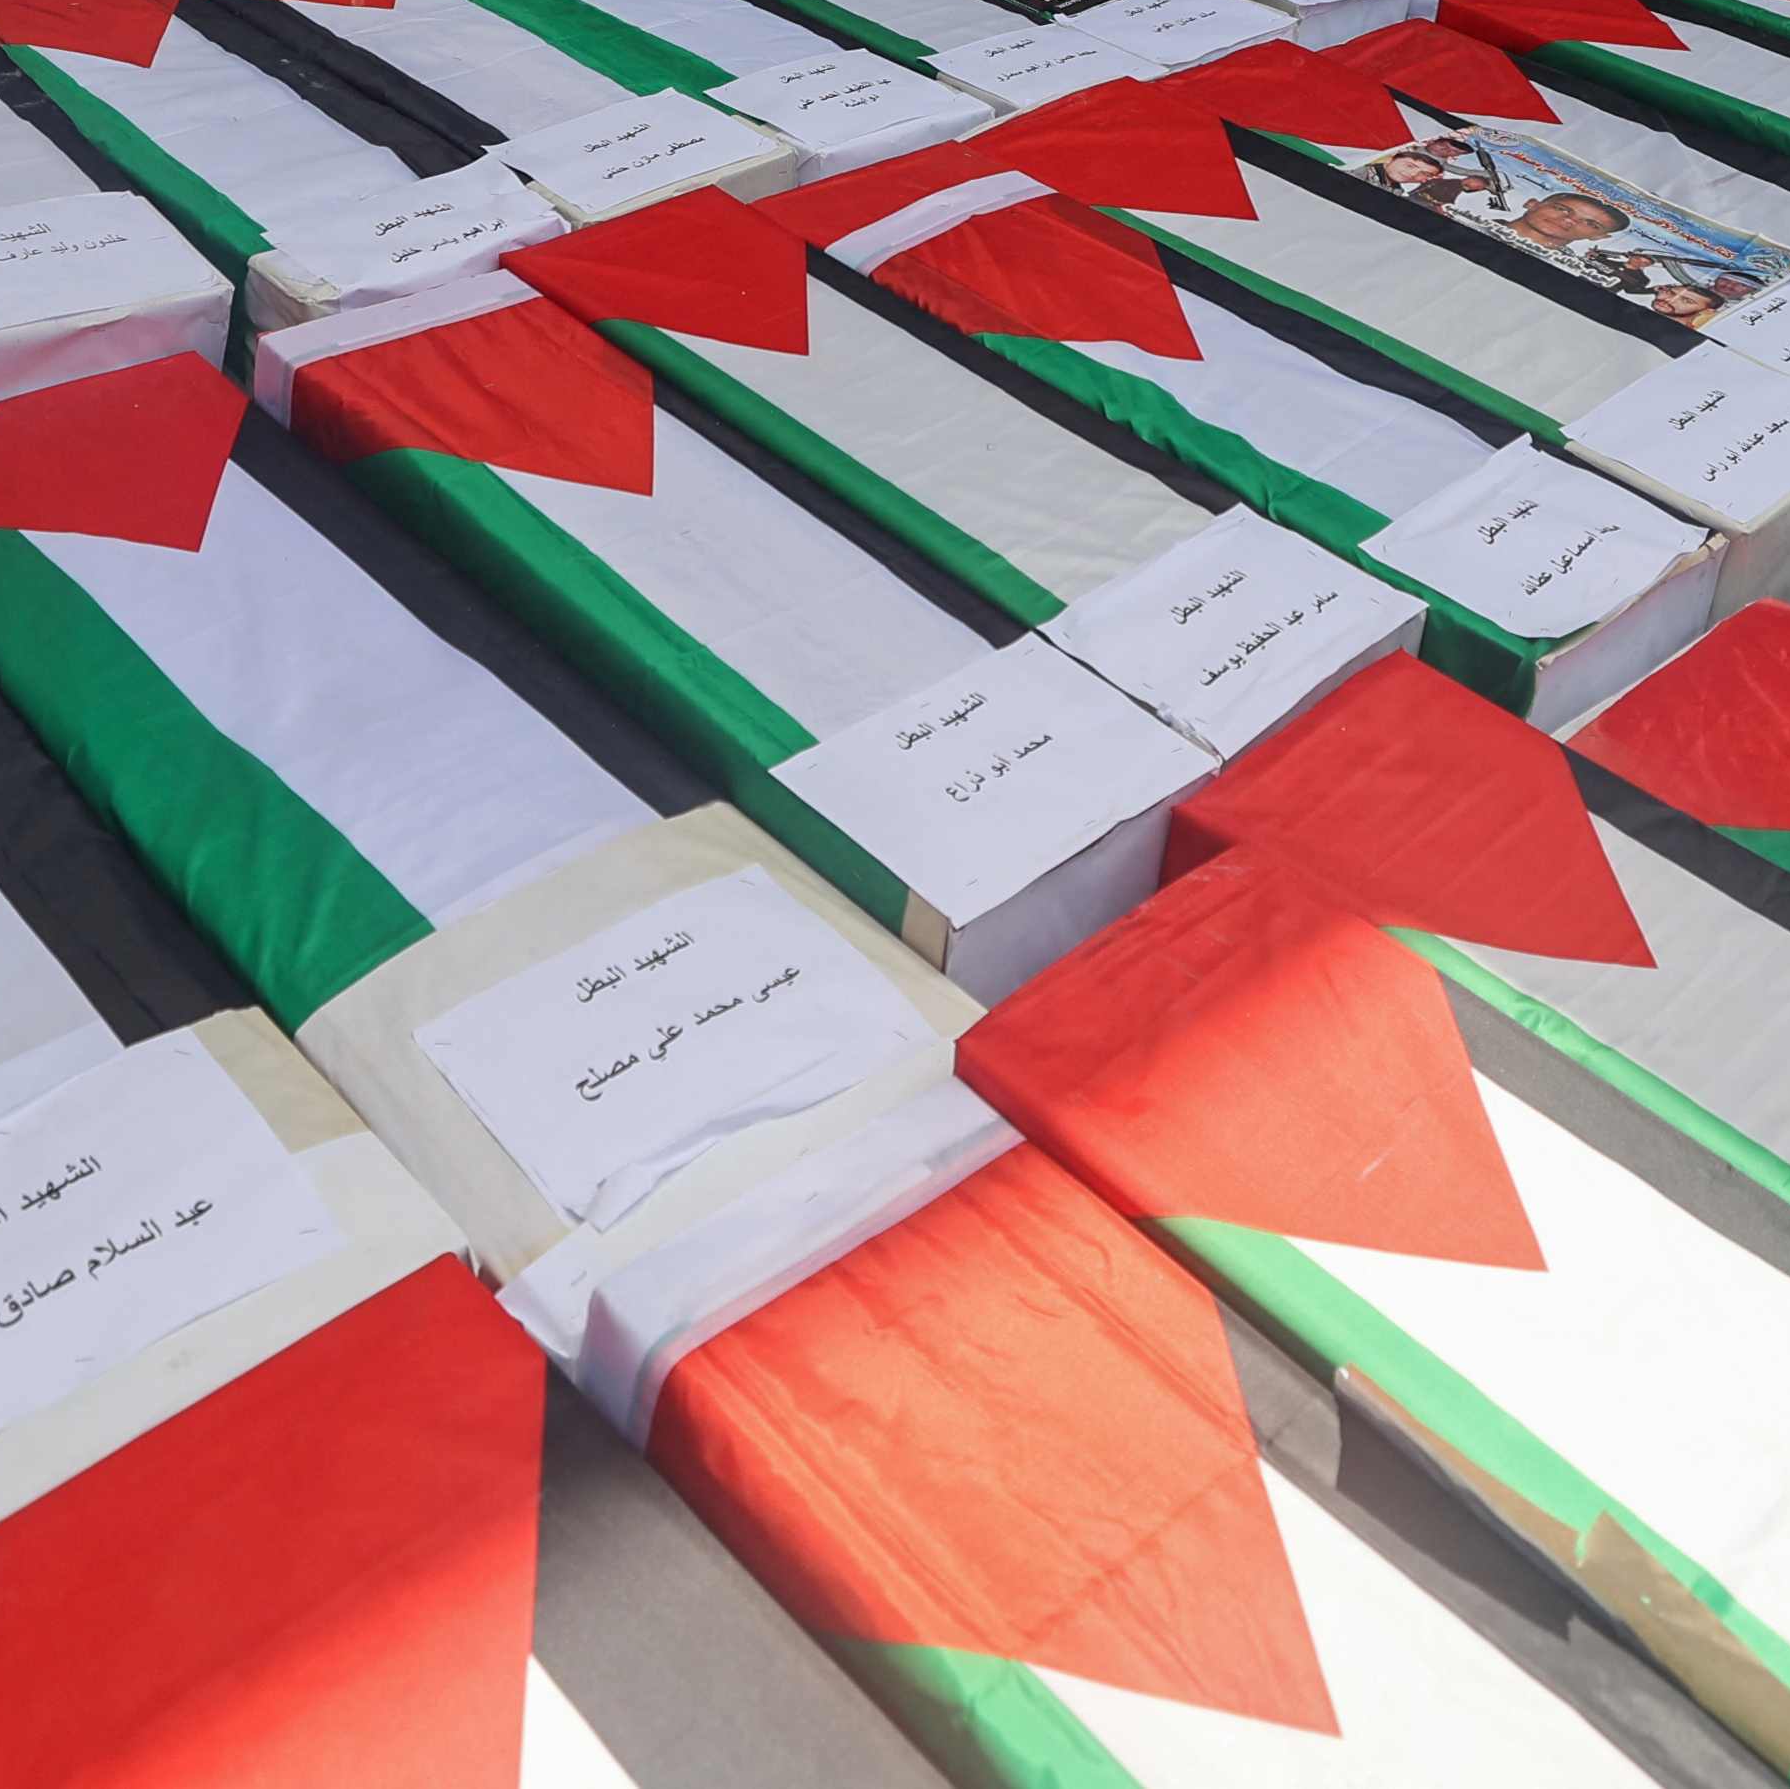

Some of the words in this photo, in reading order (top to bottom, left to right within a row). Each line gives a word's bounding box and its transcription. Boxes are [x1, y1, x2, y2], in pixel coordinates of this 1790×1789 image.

[584, 140, 612, 152] البطل
[617, 124, 650, 141] الشهيد
[415, 204, 452, 217] الشهيد
[0, 224, 51, 242] الشهيد
[376, 217, 408, 236] البطل
[1700, 391, 1725, 412] الشهيد
[1669, 412, 1695, 430] البطل
[1478, 519, 1507, 544] البطل
[1207, 571, 1245, 598] الشهيد
[1171, 597, 1204, 624] البطل
[1284, 611, 1304, 625] عبد
[1242, 624, 1280, 655] الحفيظ
[1202, 655, 1246, 686] يوسف
[940, 694, 986, 726] الشهيد
[896, 724, 935, 750] البطل
[1014, 735, 1052, 758] محمد
[635, 932, 693, 971] الشهيد
[577, 966, 626, 1003] البطل
[752, 968, 800, 1003] عيسى
[694, 998, 743, 1025] محمد
[650, 1026, 683, 1060] علي
[576, 1054, 639, 1101] مصلح
[21, 1156, 100, 1210] الشهيد
[176, 1201, 212, 1227] عبد
[88, 1219, 162, 1279] السلام
